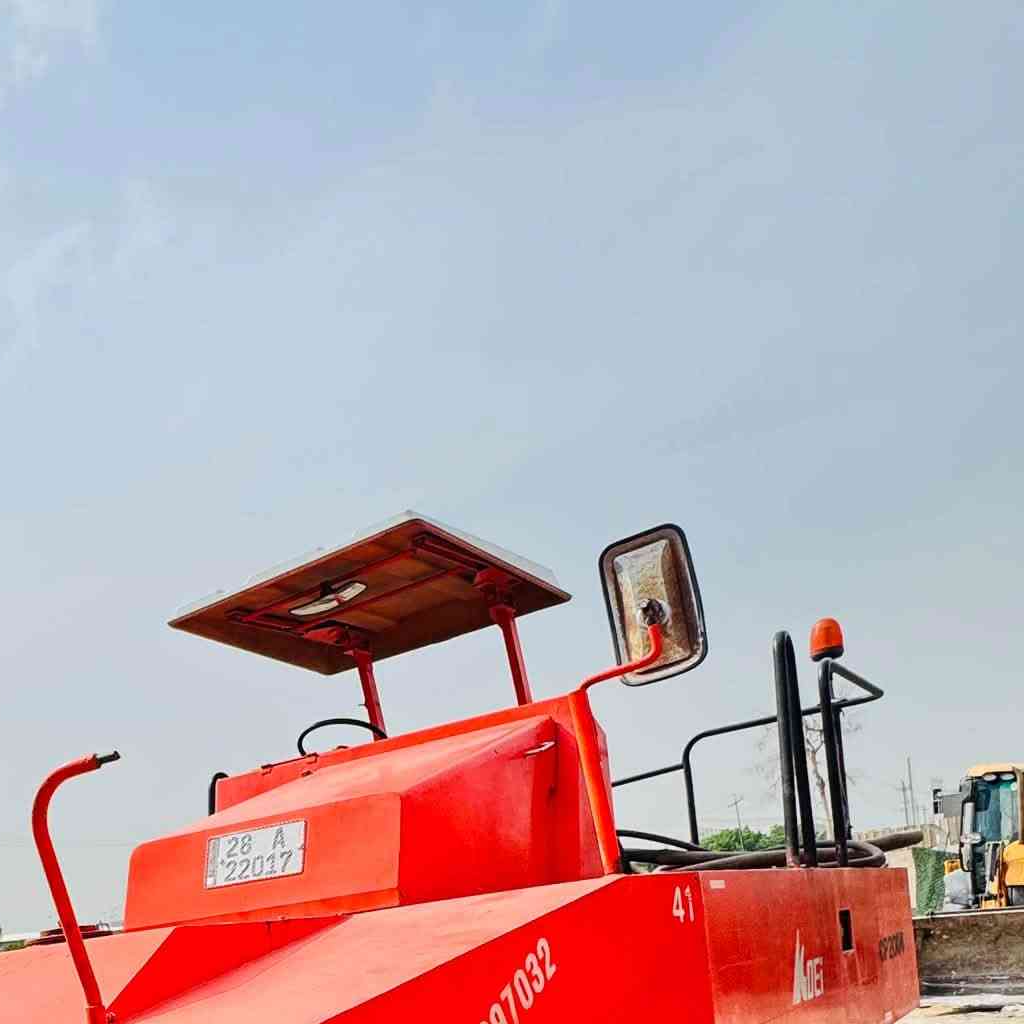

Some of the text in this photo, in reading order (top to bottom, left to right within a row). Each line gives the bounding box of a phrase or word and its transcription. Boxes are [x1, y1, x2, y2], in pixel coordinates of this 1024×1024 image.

[272, 826, 287, 850] A
[224, 849, 294, 882] 22017
[672, 883, 695, 924] 41
